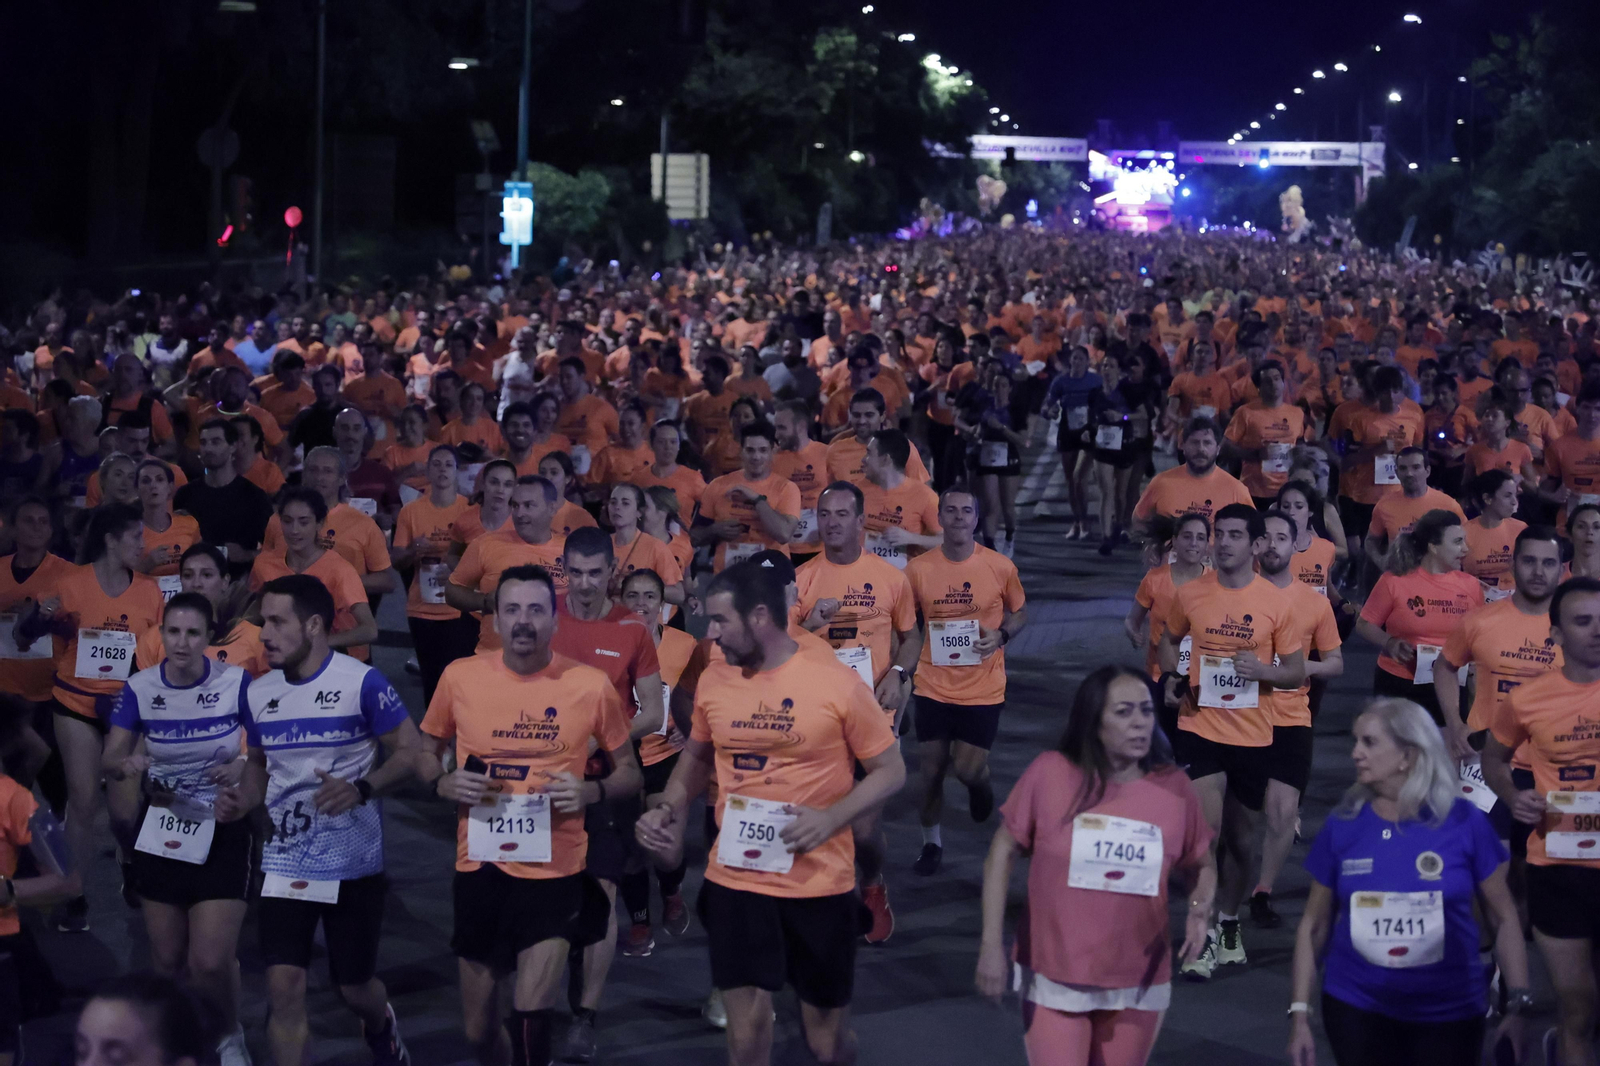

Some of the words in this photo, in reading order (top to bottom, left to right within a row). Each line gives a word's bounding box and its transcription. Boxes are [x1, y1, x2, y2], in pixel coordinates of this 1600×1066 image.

[933, 598, 958, 606] SEVILLA
[1205, 627, 1236, 639] SEVILLA
[1220, 623, 1255, 634] NOCTURNA
[940, 635, 971, 648] 15088
[90, 645, 127, 660] 21628
[1500, 650, 1534, 661] SEVILLA
[1518, 646, 1556, 658] NOCTURNA
[196, 692, 220, 705] ACS
[314, 690, 342, 704] ACS
[750, 713, 796, 722] NOCTURNA
[513, 722, 560, 732] NOCTURNA
[731, 720, 769, 730] SEVILLA
[770, 723, 794, 732] KH7
[1573, 724, 1600, 734] NOCTU
[491, 730, 533, 739] SEVILLA
[534, 731, 559, 741] KH7
[1553, 732, 1593, 743] SEVILLA
[159, 814, 202, 836] 18187
[487, 816, 535, 834] 12113
[738, 821, 775, 842] 7550
[1093, 840, 1146, 863] 17404
[1372, 916, 1426, 937] 17411
